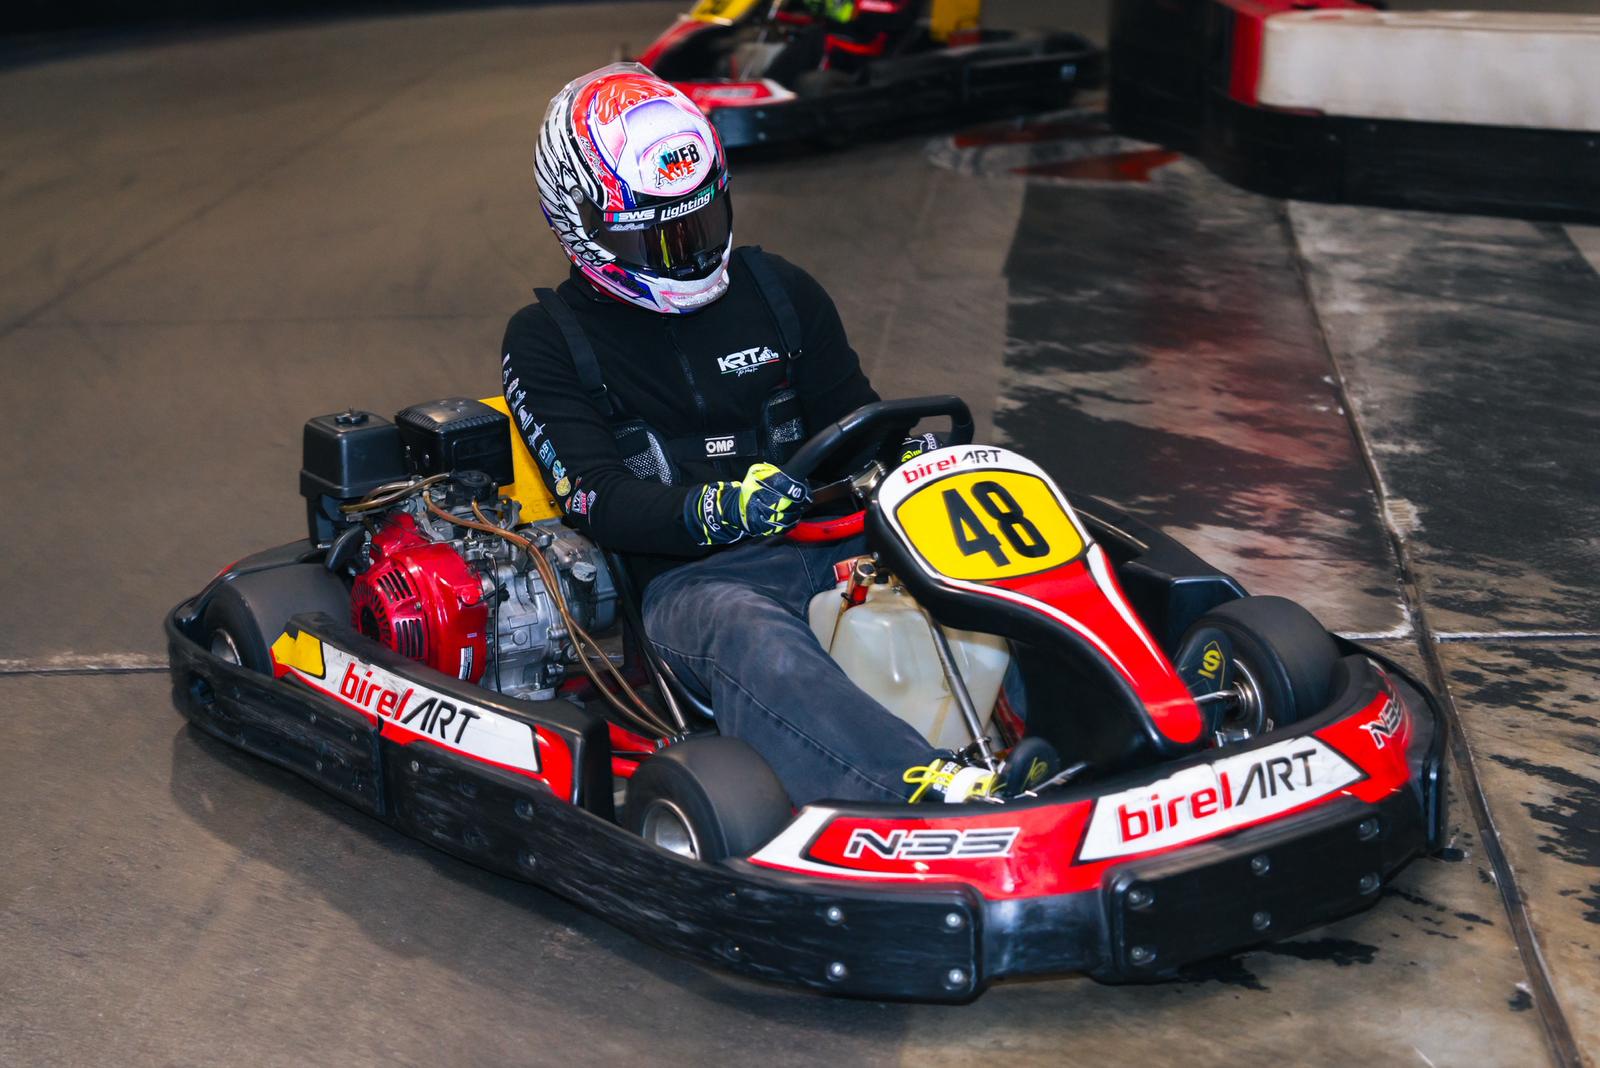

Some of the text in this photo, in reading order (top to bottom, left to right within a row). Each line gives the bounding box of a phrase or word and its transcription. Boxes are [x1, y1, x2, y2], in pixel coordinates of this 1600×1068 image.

[660, 192, 710, 221] Lighting
[717, 347, 760, 371] KRT
[705, 440, 734, 454] OMP
[704, 486, 721, 532] sparco
[942, 481, 1050, 567] 48
[843, 827, 1021, 860] N-35
